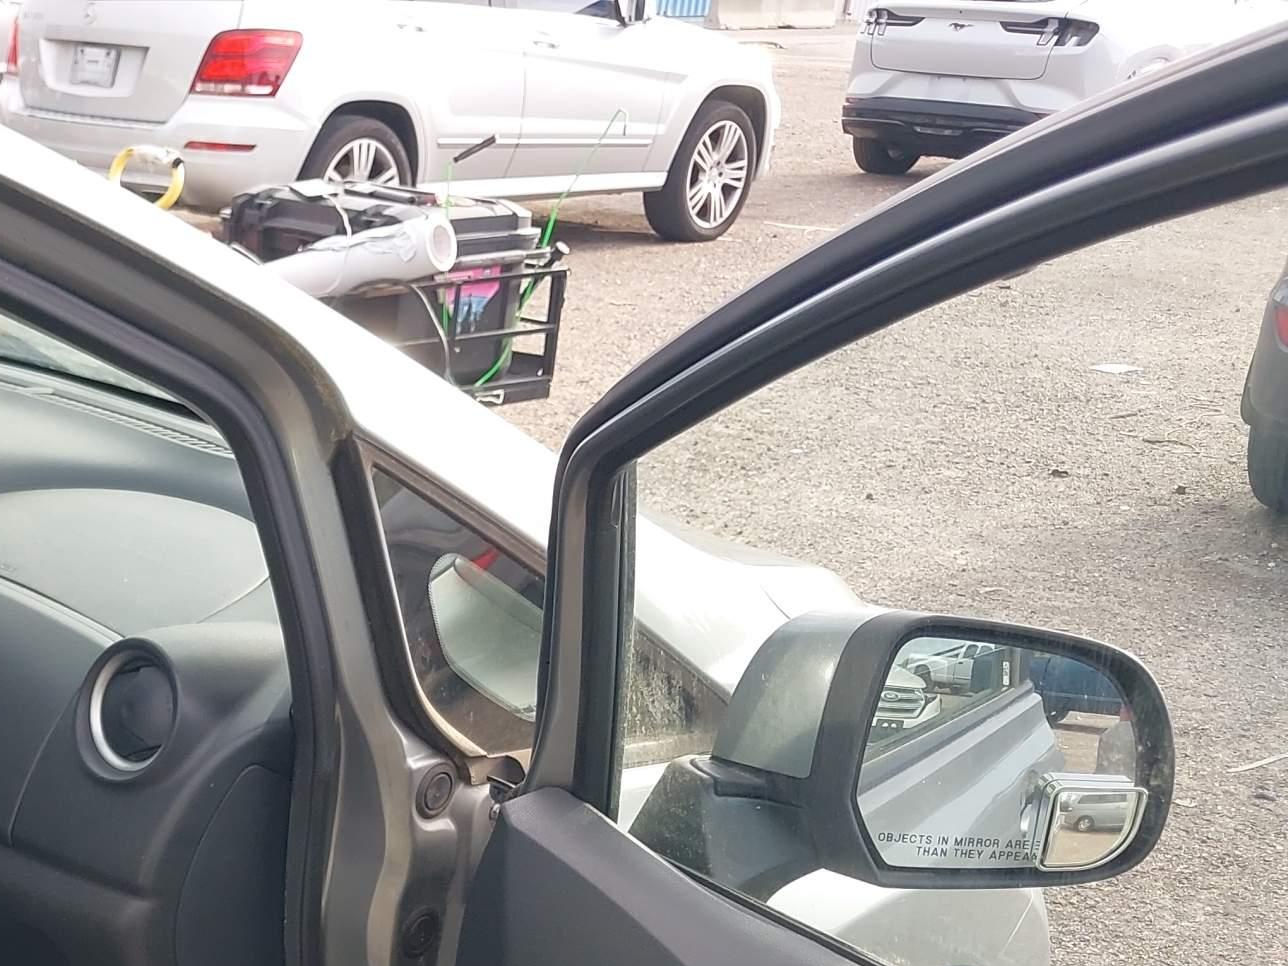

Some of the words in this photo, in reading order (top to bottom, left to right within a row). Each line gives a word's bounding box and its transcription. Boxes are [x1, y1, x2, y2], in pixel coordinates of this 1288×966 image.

[878, 832, 933, 845] OBJECTS
[937, 835, 949, 846] IN
[954, 837, 1000, 849] MIRROR
[1005, 839, 1030, 850] ARE
[917, 846, 948, 857] THAN
[954, 848, 984, 859] THEY
[989, 850, 1031, 862] APPEA
